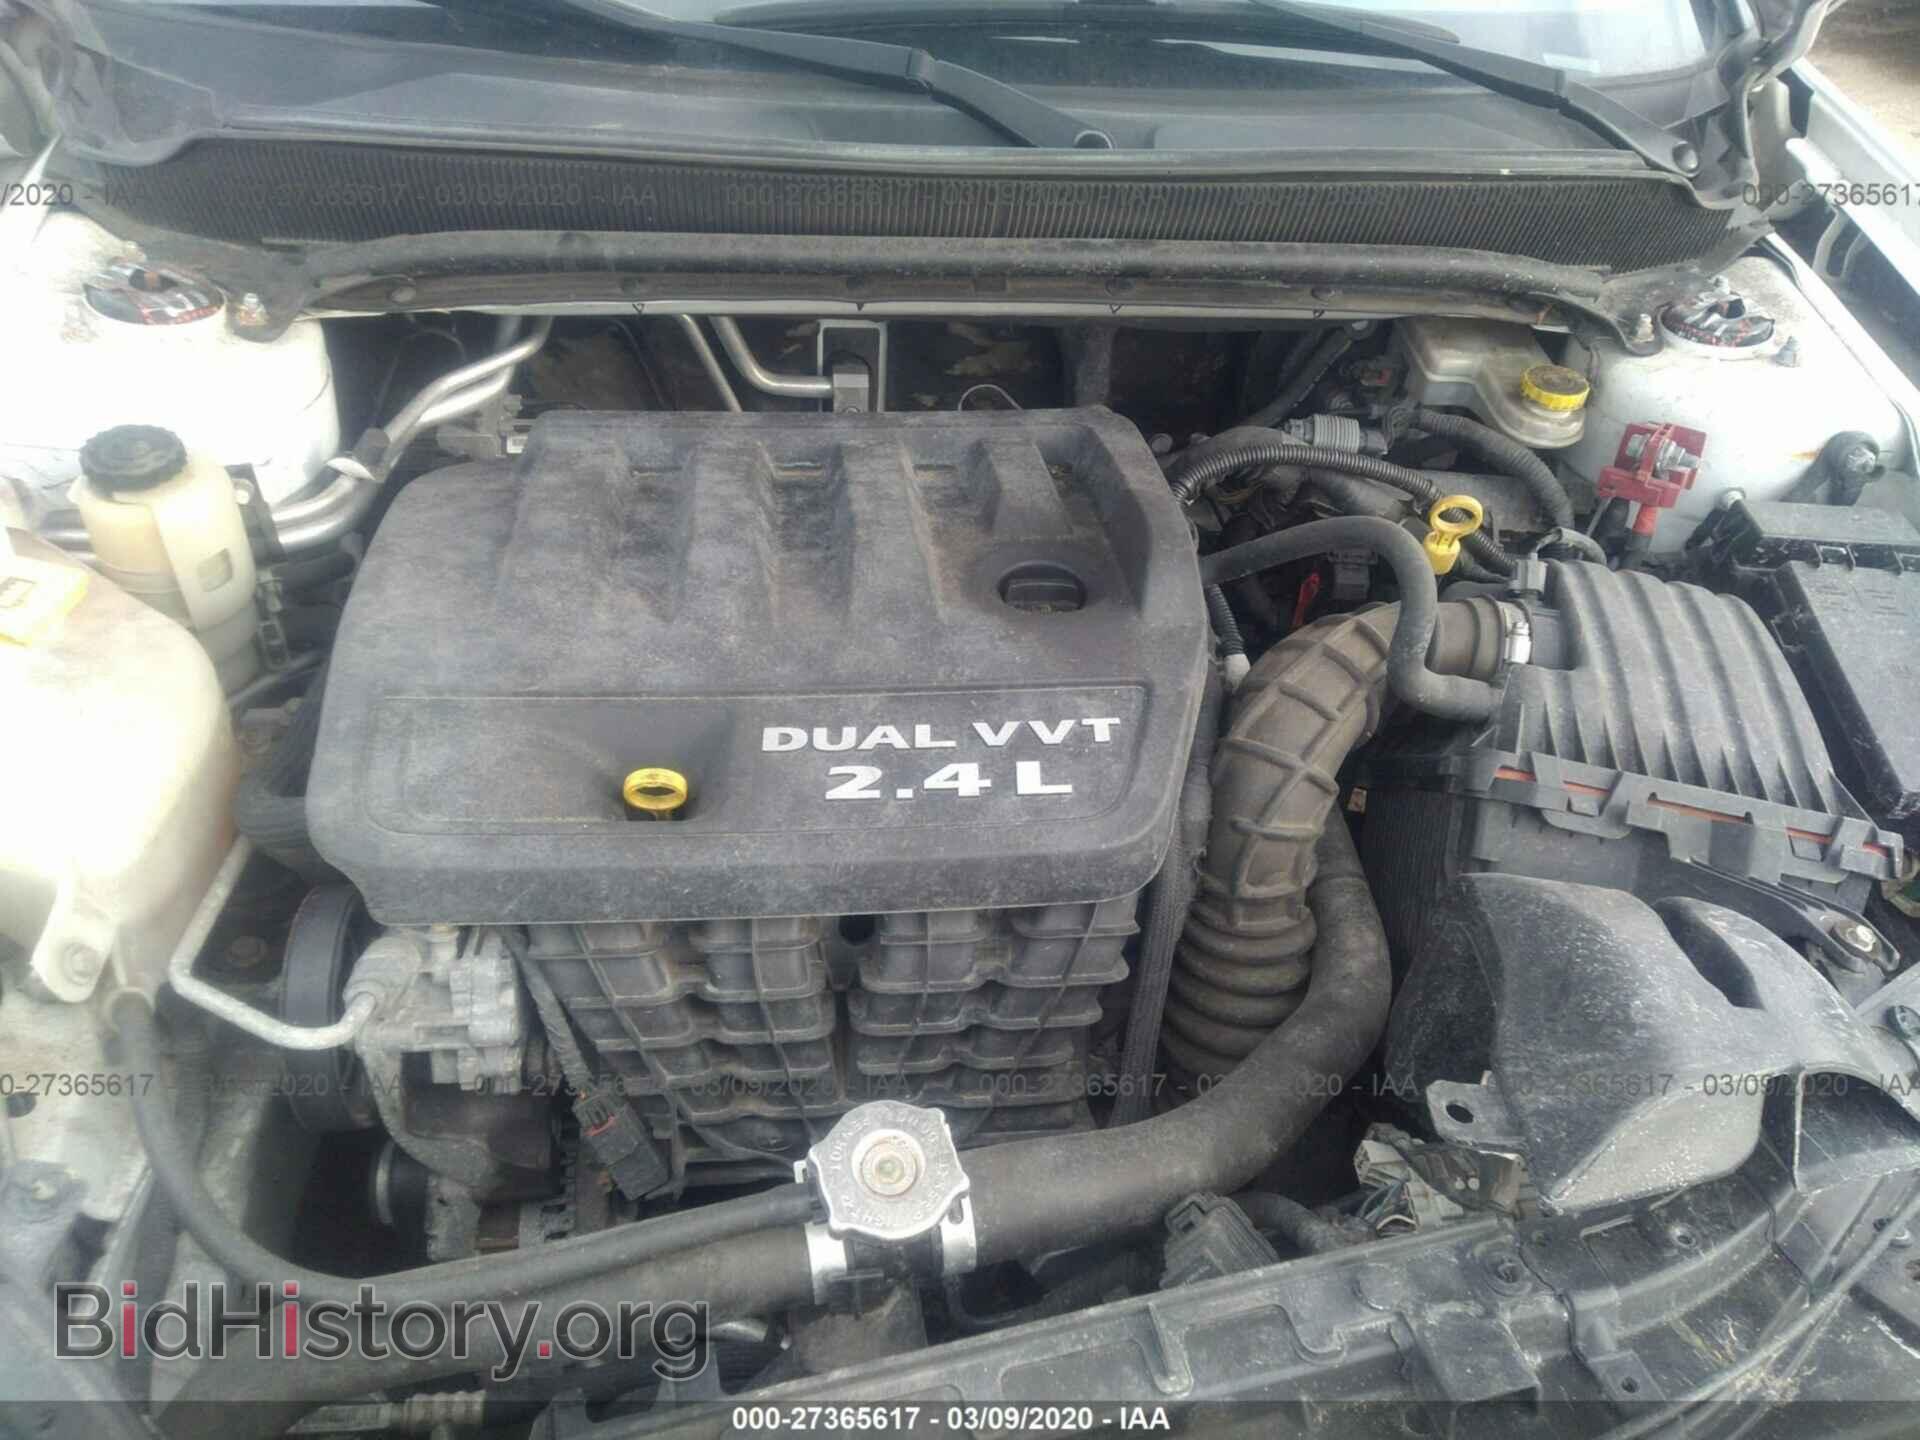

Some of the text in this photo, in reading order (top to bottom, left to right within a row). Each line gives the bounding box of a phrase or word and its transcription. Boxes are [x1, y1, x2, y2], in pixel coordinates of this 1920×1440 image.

[761, 717, 1121, 752] DUAL VVT
[825, 762, 992, 800] 2.4
